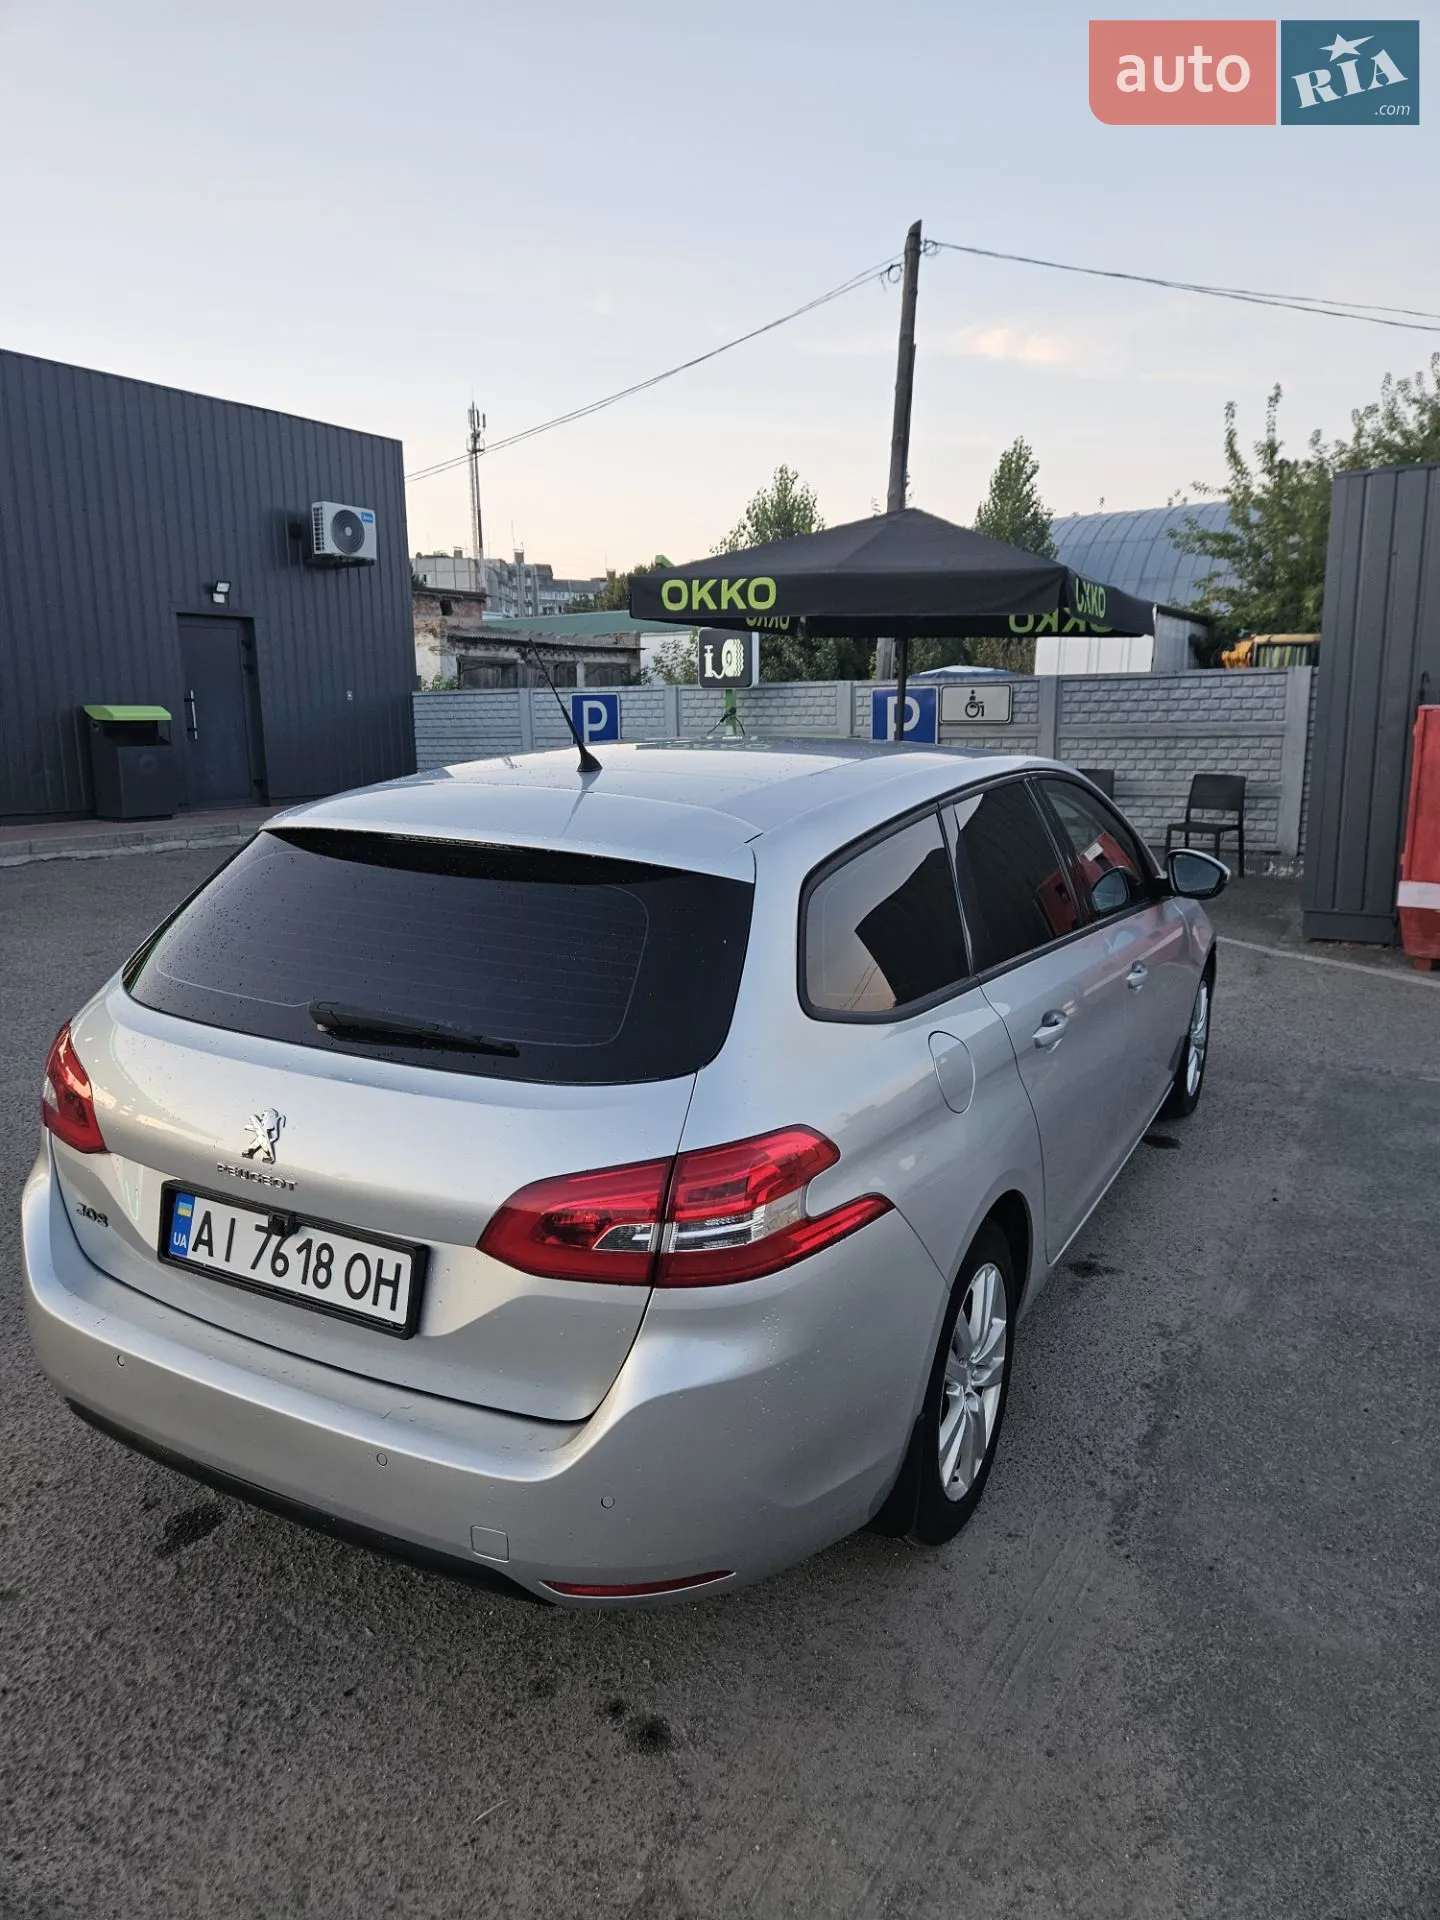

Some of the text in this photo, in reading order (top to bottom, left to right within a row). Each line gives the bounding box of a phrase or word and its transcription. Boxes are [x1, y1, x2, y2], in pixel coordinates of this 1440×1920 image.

[661, 577, 777, 611] OKKO
[582, 700, 608, 743] P
[887, 695, 921, 741] P
[217, 1162, 298, 1191] PEUGEOT
[76, 1201, 109, 1228] 308
[173, 1231, 188, 1249] UA
[191, 1210, 402, 1312] AI 7618 OH
